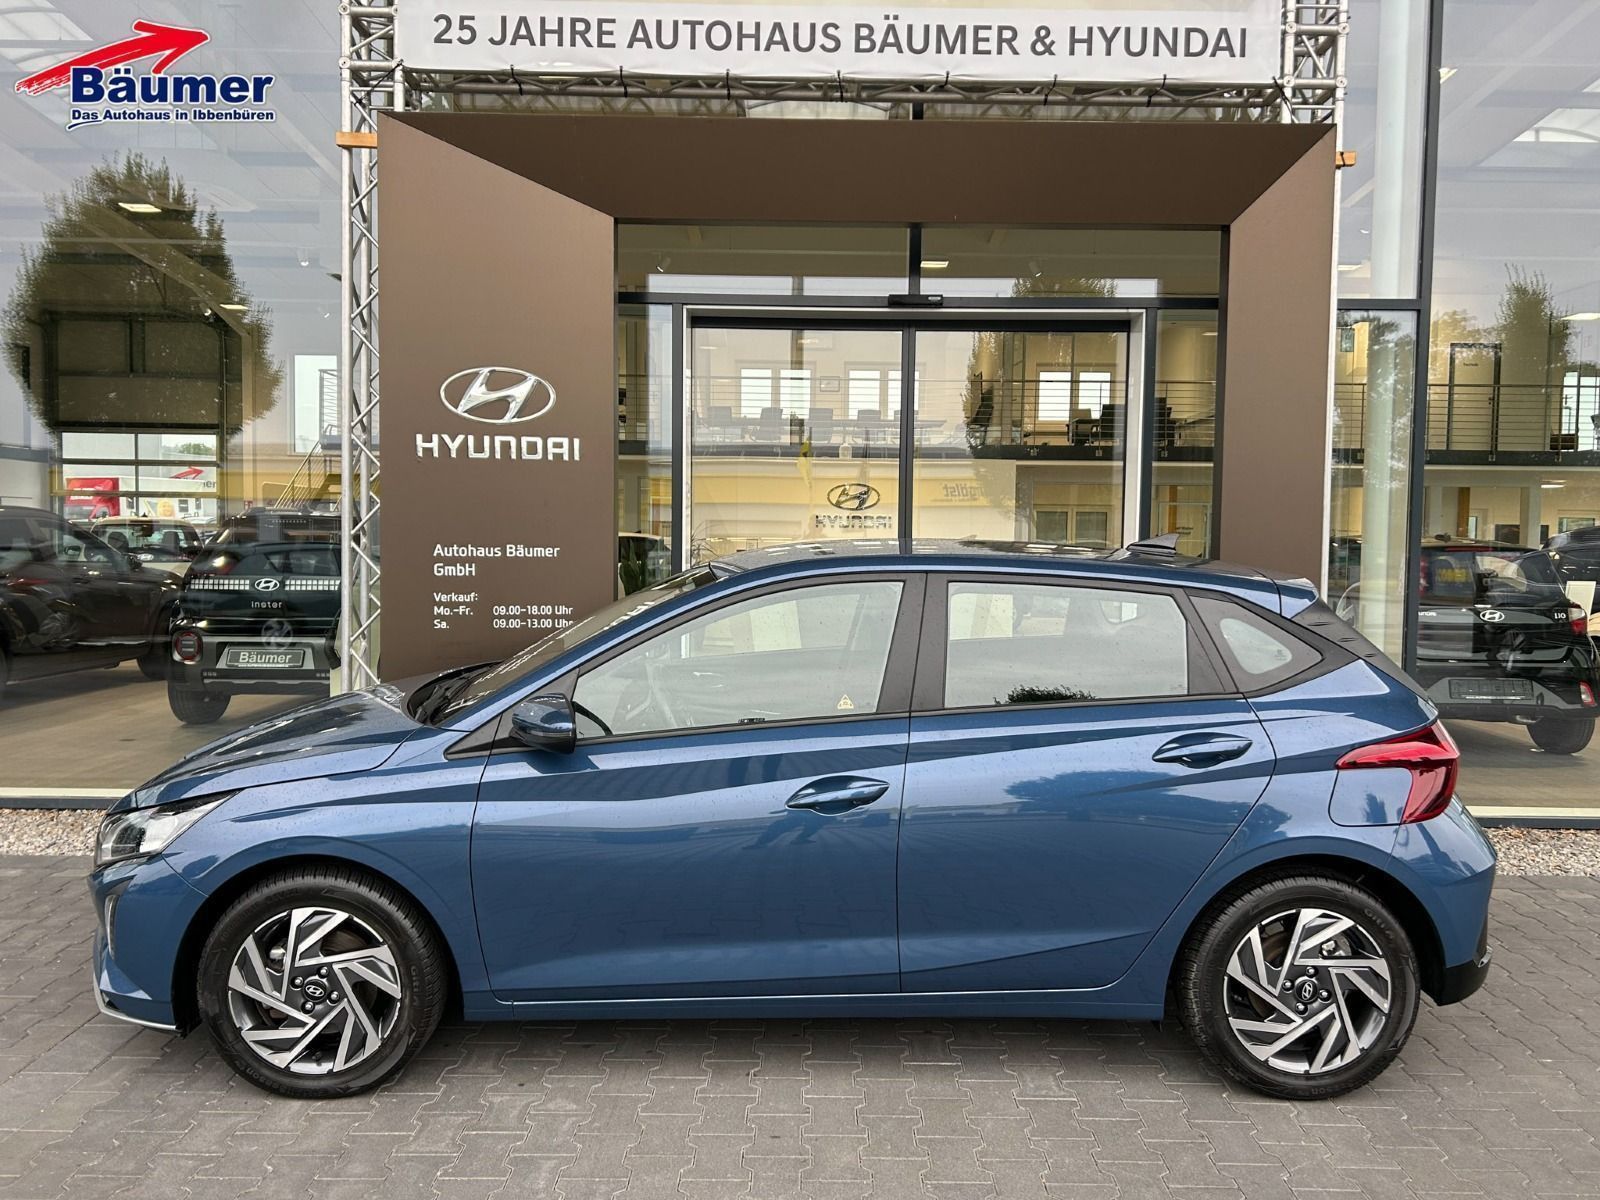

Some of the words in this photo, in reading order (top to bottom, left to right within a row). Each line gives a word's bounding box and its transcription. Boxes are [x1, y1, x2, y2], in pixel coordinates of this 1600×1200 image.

[433, 14, 477, 45] 25
[488, 15, 617, 48] JAHRE
[627, 18, 841, 53] AUTOHAUS
[853, 14, 1020, 56] BÄUMER
[1029, 25, 1057, 56] &
[1068, 26, 1248, 58] HYUNDAI
[415, 433, 580, 461] HYUNDAI
[815, 514, 892, 529] HYUNDAI
[433, 543, 502, 557] Autohaus
[506, 544, 561, 557] Bäumer
[433, 562, 476, 576] GmbH
[433, 592, 478, 602] Verkauf:
[555, 605, 573, 615] Uhr
[433, 619, 450, 629] Sa.
[239, 651, 292, 663] Bäumer
